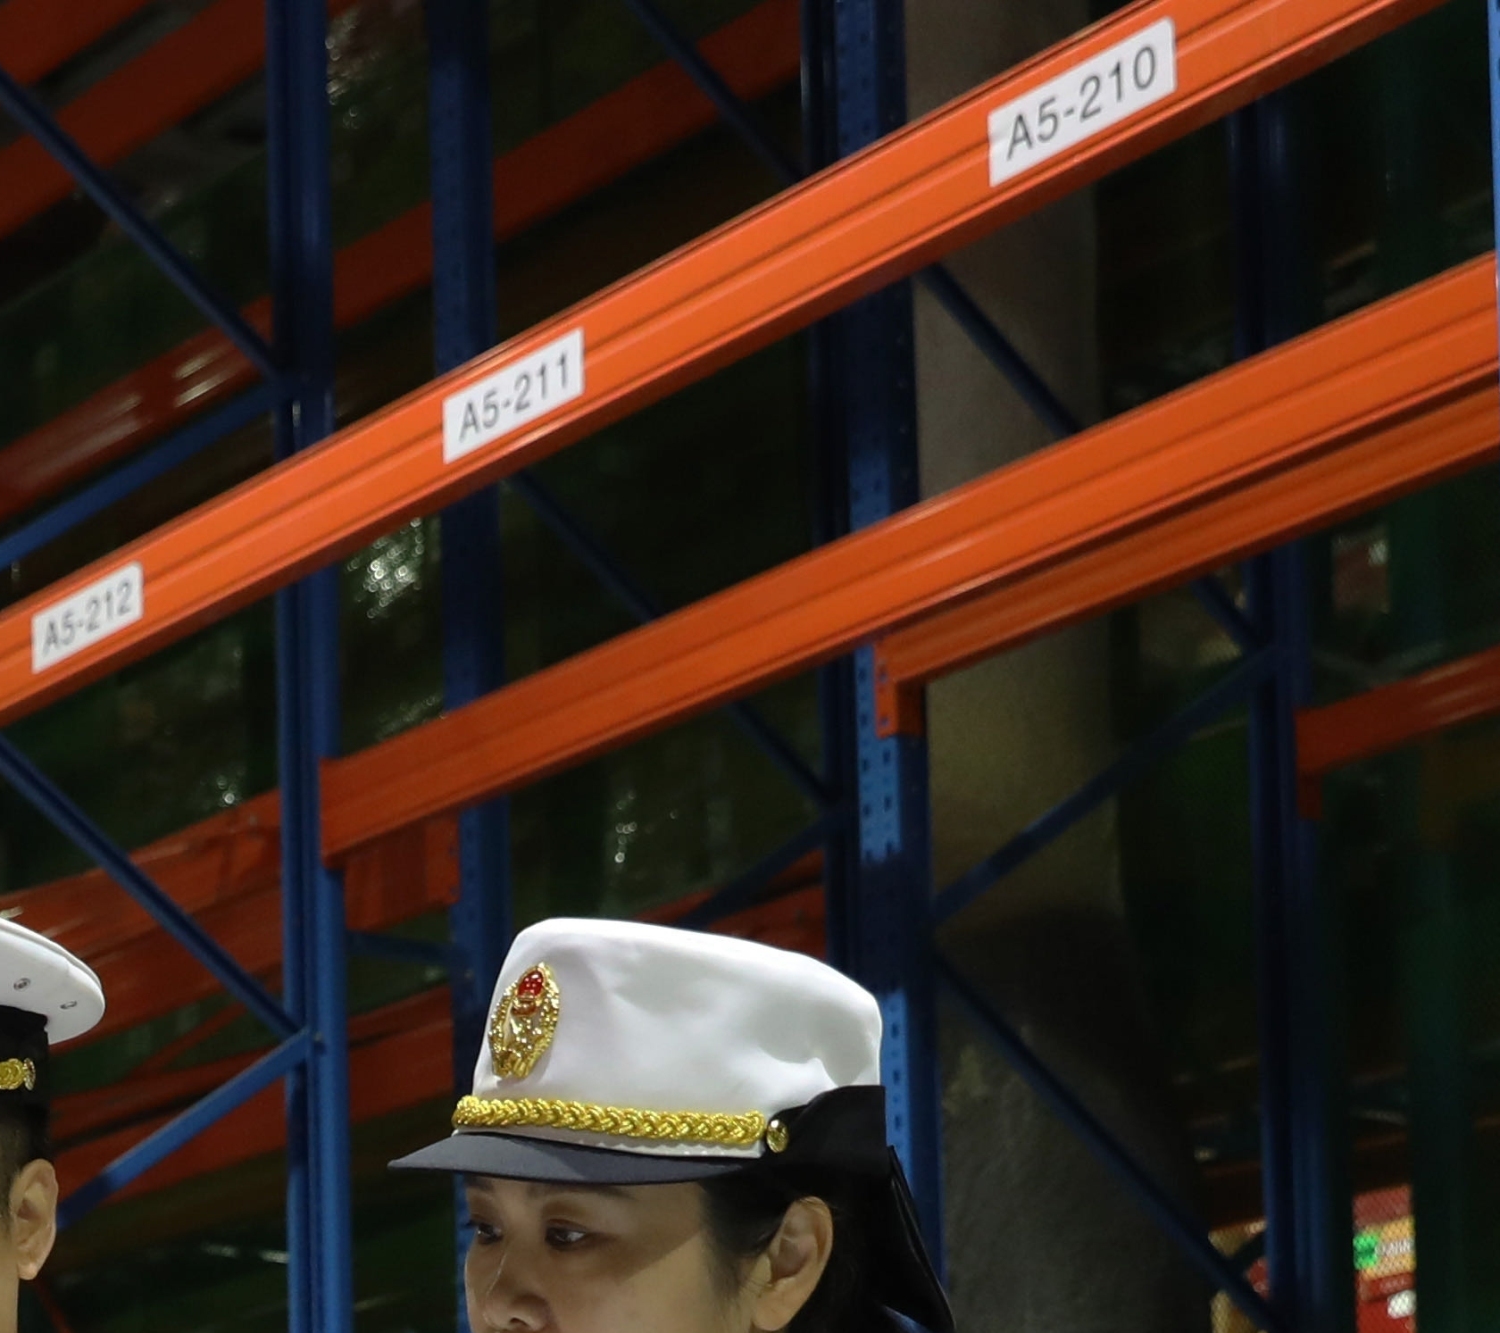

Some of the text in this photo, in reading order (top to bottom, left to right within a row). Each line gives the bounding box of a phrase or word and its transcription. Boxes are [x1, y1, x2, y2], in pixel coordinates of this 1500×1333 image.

[1005, 46, 1157, 161] A5-210
[459, 352, 567, 442] A5-211
[42, 579, 132, 656] A5-212
